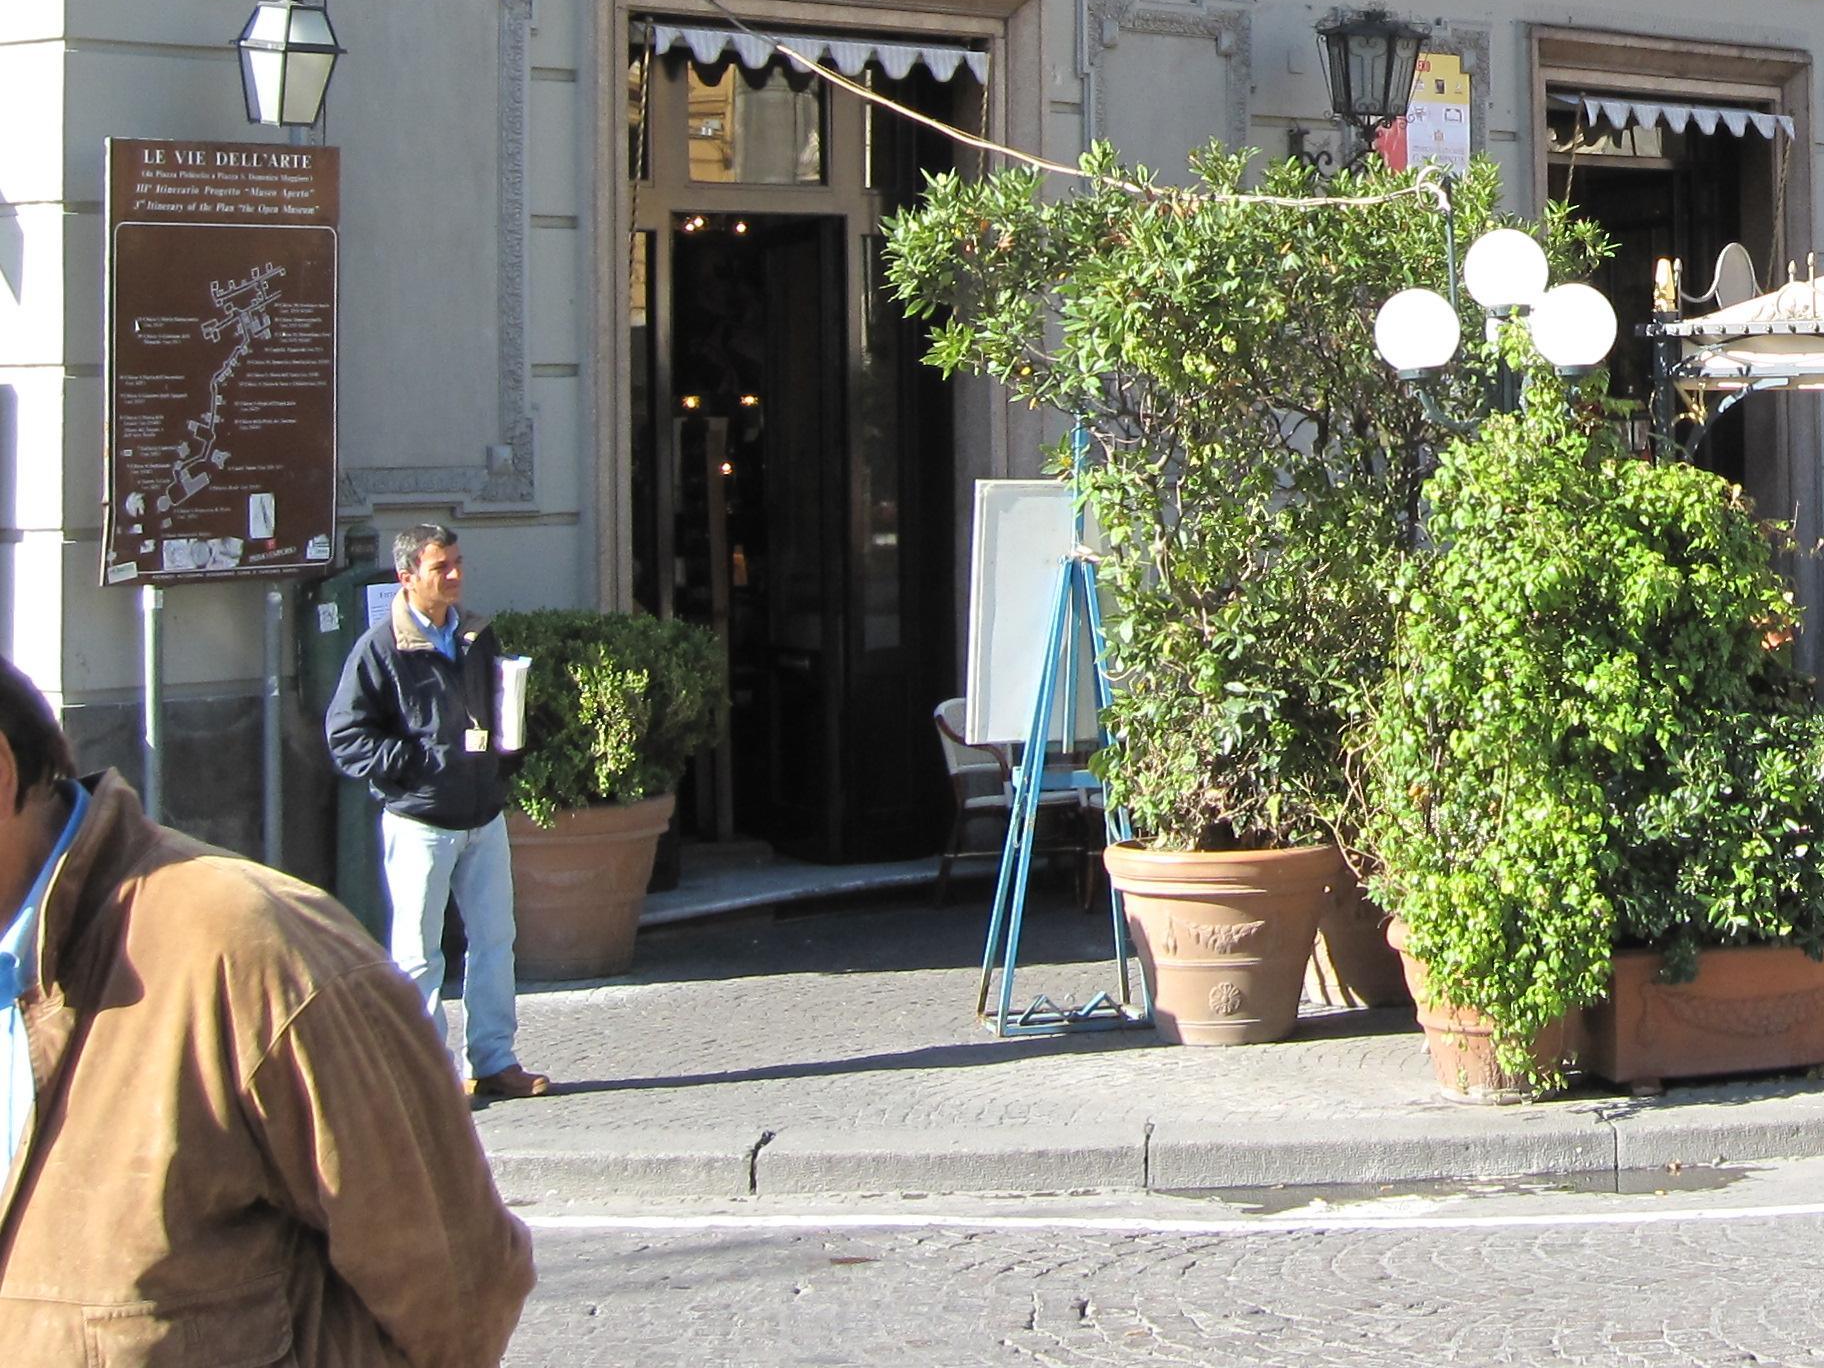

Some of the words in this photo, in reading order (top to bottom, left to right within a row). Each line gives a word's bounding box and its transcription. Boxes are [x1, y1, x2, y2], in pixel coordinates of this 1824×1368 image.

[143, 149, 166, 164] LE
[175, 150, 206, 166] VIE
[215, 151, 312, 169] DELL'ARTE
[156, 184, 200, 195] Itinerario
[147, 199, 184, 213] Itinerary
[187, 201, 197, 211] of
[199, 202, 212, 211] the
[216, 203, 235, 213] Plan
